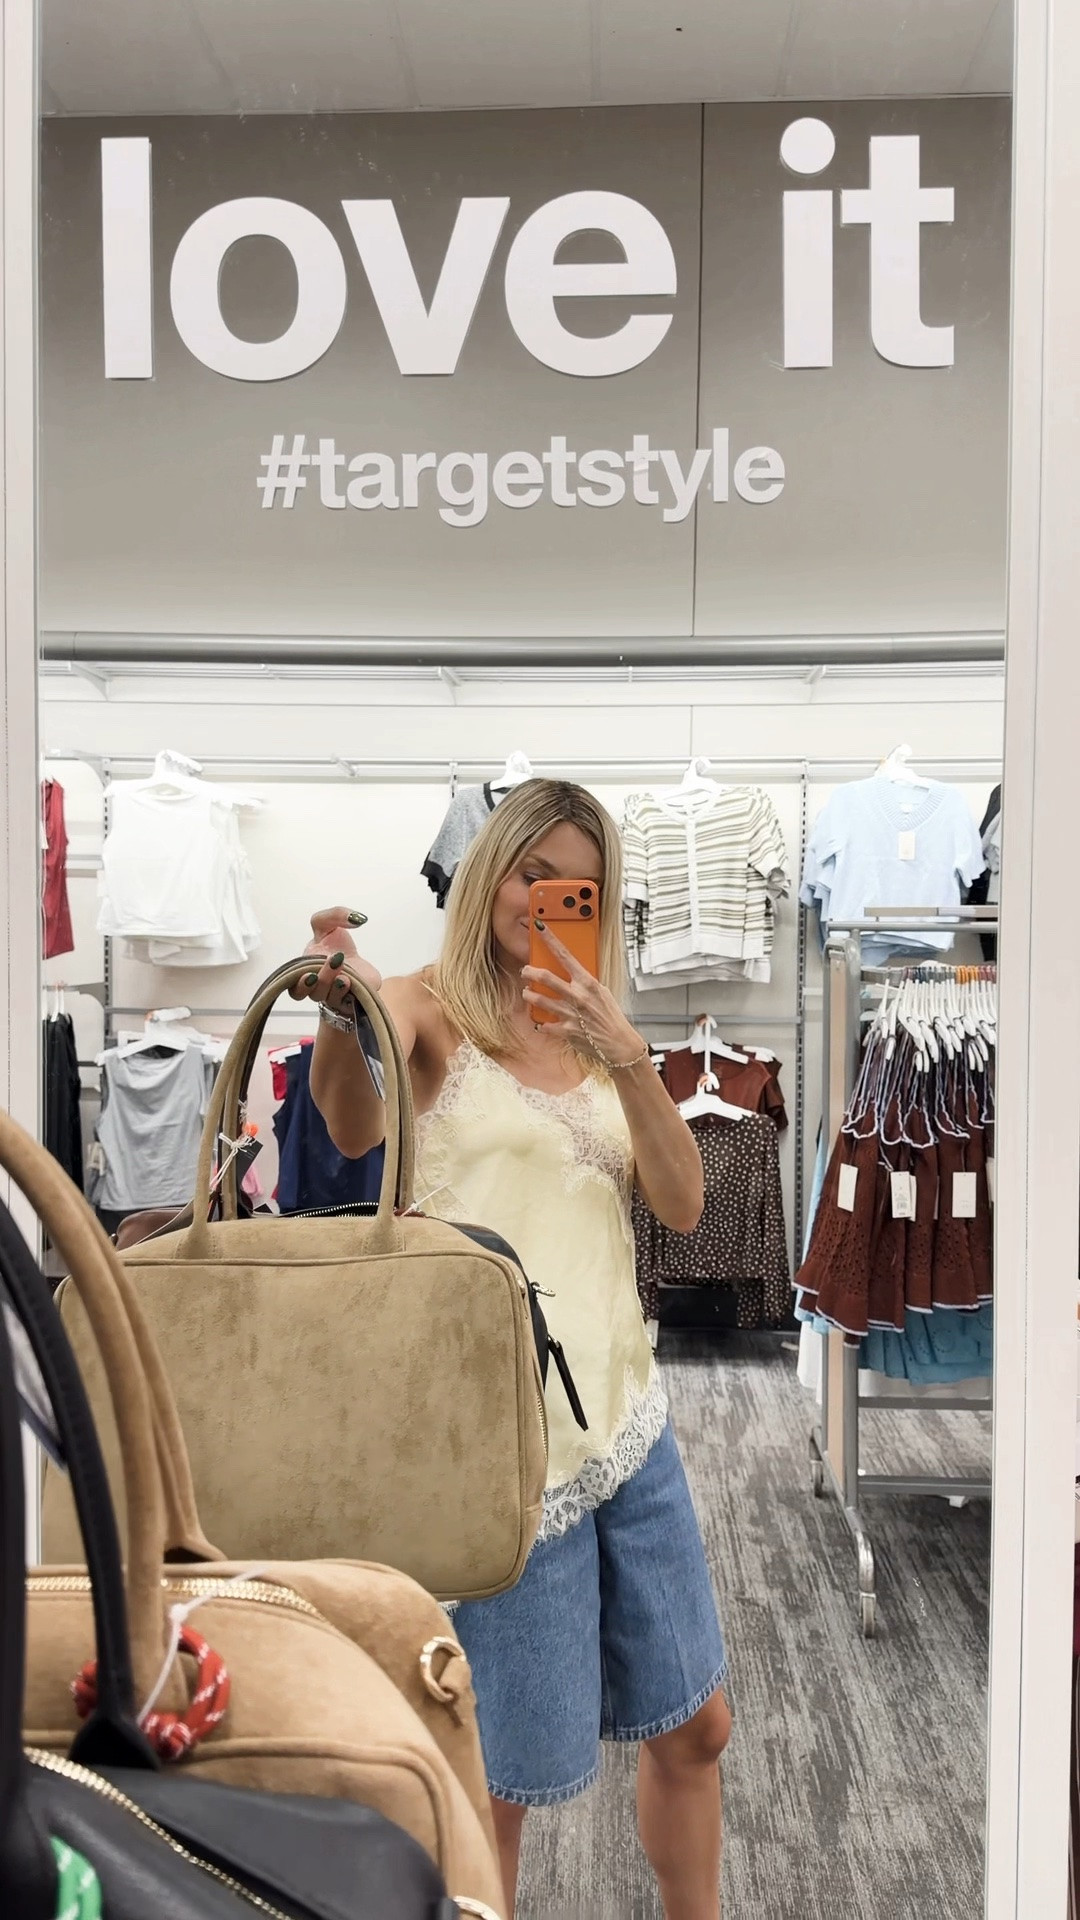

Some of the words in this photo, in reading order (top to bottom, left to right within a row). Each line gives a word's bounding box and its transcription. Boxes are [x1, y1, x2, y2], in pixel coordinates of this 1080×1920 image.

[101, 136, 678, 381] love
[780, 117, 955, 369] it
[257, 428, 786, 528] #targetstyle
